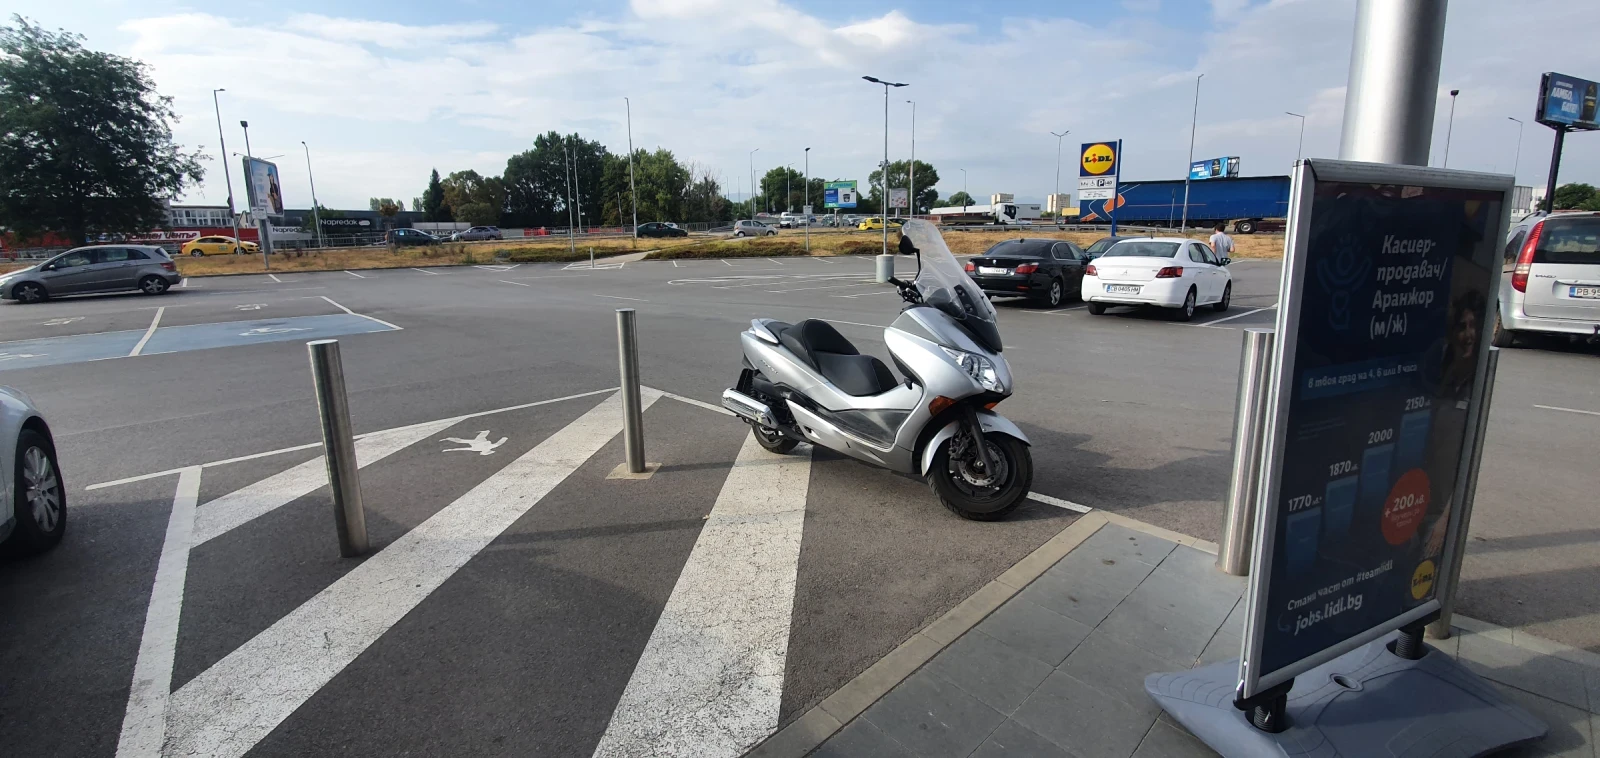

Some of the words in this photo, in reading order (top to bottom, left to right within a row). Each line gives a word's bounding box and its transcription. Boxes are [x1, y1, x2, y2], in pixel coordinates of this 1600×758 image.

[320, 219, 358, 227] Napredak
[1382, 234, 1436, 257] Касиер-
[1376, 257, 1448, 285] продавач/
[1372, 287, 1434, 312] Аранжор
[1370, 312, 1407, 340] (м/ж)
[1315, 376, 1336, 387] твоя
[1338, 374, 1356, 385] град
[1358, 372, 1367, 380] на
[1383, 367, 1396, 376] или
[1405, 397, 1424, 410] 2150
[1368, 428, 1393, 444] 2000
[1329, 460, 1352, 476] 1870
[1288, 494, 1311, 511] 1770
[1392, 493, 1414, 512] 200
[1288, 592, 1316, 611] Стани
[1318, 583, 1340, 597] част
[1341, 576, 1354, 588] от
[1356, 559, 1393, 583] #teamlidl
[1294, 594, 1363, 636] jobs.lidl.bg
